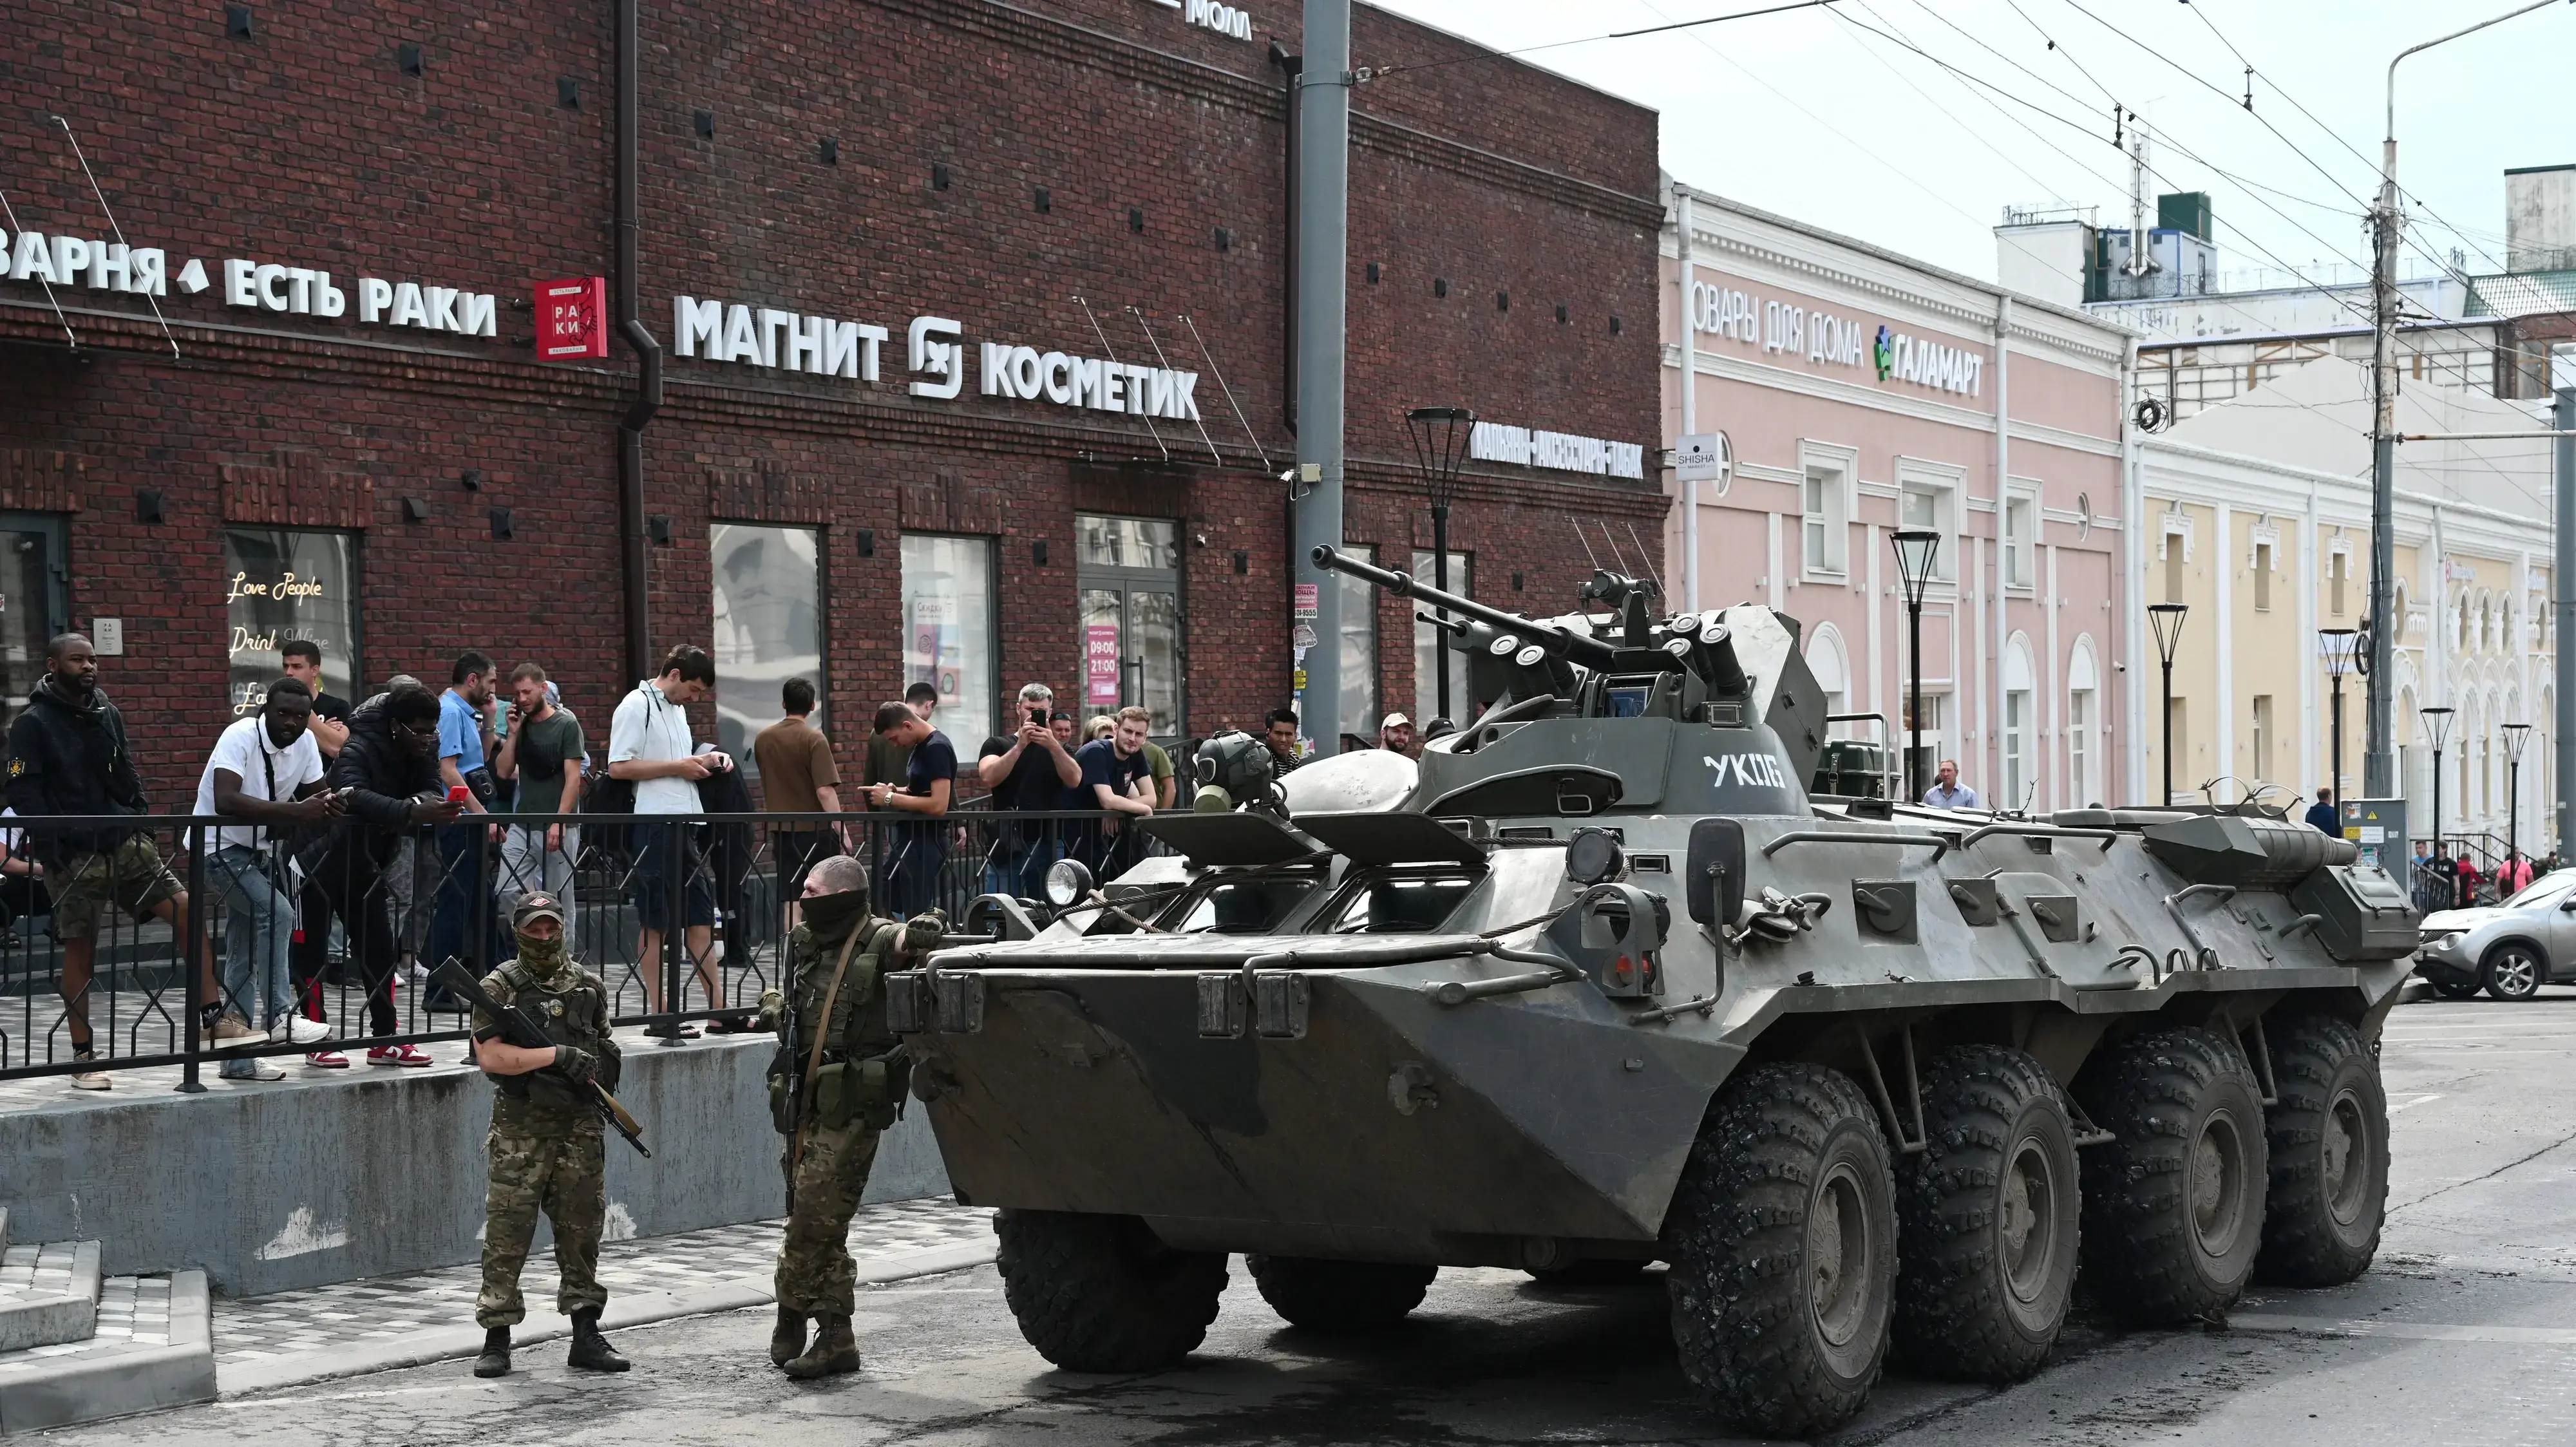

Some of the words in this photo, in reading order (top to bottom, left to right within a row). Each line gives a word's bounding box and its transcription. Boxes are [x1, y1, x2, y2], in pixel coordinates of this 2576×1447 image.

[1186, 0, 1252, 41] МОЛЛ
[224, 259, 345, 317] ЕСТЬ
[359, 278, 496, 337] РАКИ
[1693, 281, 1759, 343] ОВАРЫ
[1763, 301, 1803, 355] ДЛЯ
[1806, 312, 1864, 368] ДОМА
[674, 296, 887, 381] МАГНИТ
[981, 342, 1201, 421] КОСМЕТИК
[1891, 334, 1984, 396] ГАЛАМАРТ
[1470, 421, 1531, 465] КАЛЬЯНЫ
[1533, 430, 1606, 475] АКСЕССУАРЫ
[1605, 440, 1643, 480] ТАБАК
[1678, 454, 1715, 464] SHISHA
[227, 571, 267, 604] Love
[272, 572, 322, 606] People
[229, 627, 277, 659] Drink
[1090, 641, 1115, 654] 09:00
[1091, 659, 1115, 672] 21:00
[234, 682, 267, 715] Ea
